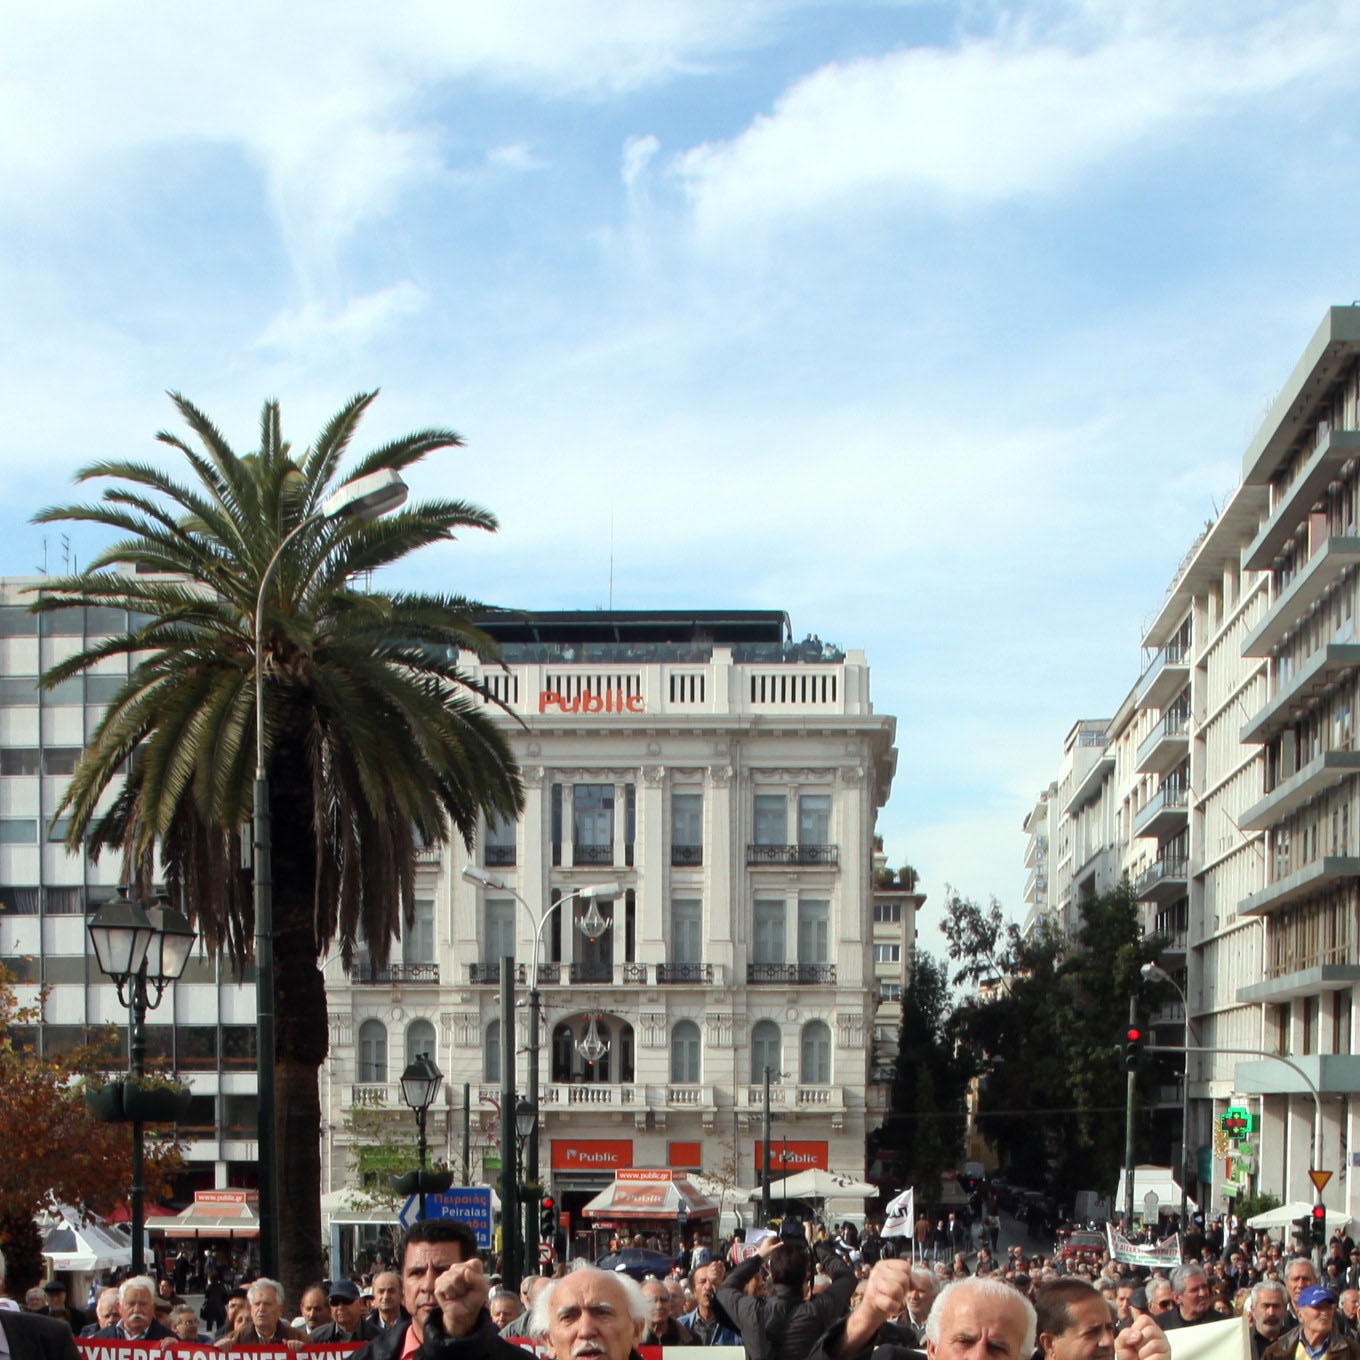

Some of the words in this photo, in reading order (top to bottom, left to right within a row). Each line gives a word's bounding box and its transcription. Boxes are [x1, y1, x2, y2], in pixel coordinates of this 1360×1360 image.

[539, 688, 644, 712] Public
[579, 1152, 618, 1162] Public
[619, 1172, 669, 1180] www.public.gr
[442, 1207, 487, 1217] Peiraias
